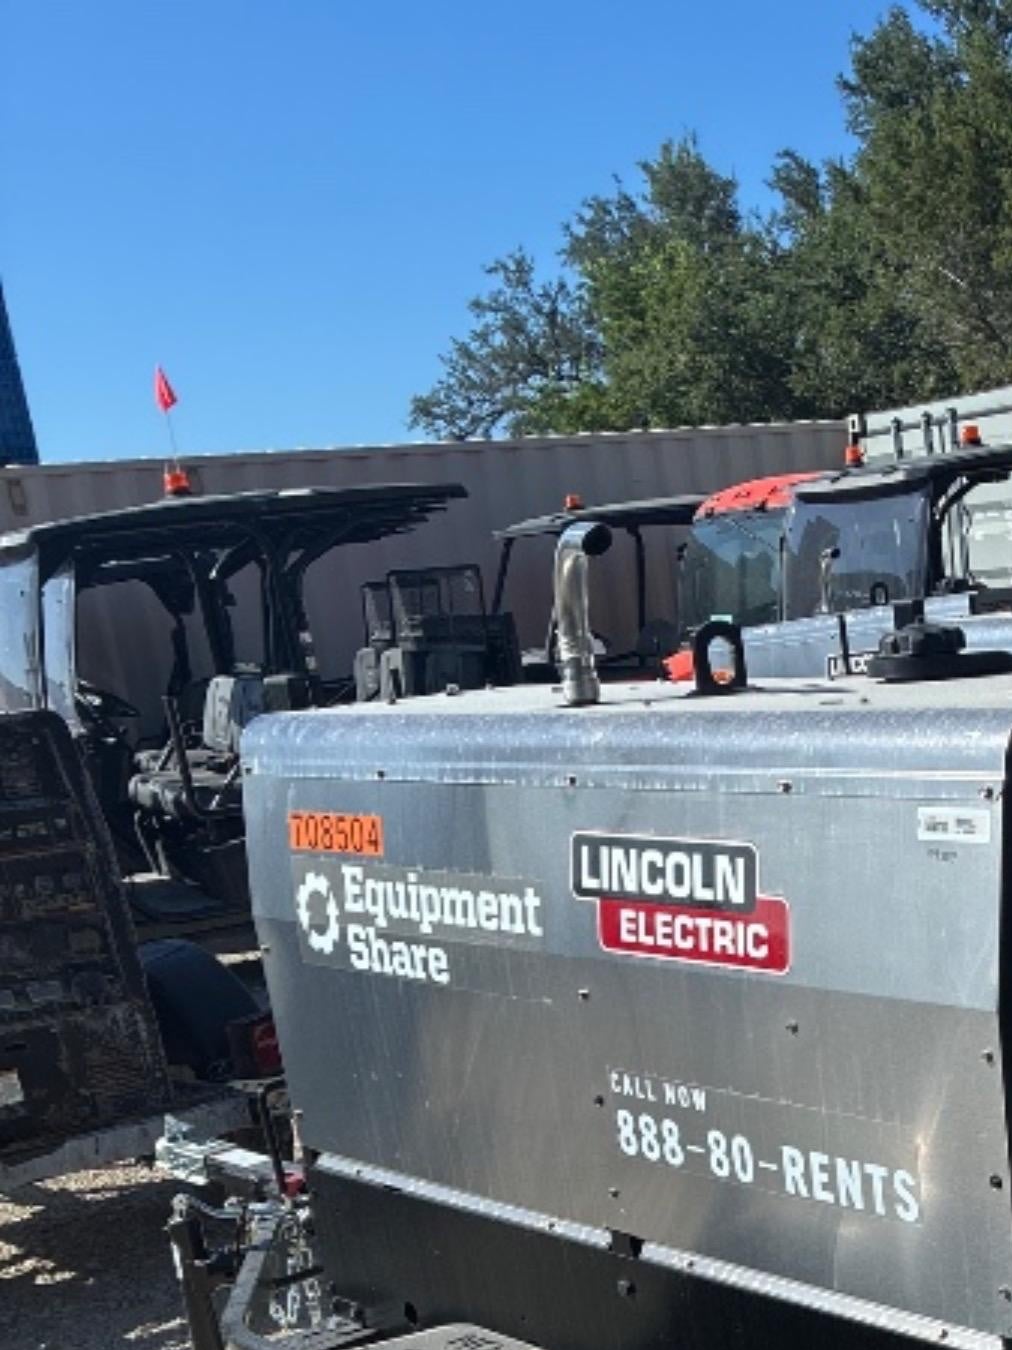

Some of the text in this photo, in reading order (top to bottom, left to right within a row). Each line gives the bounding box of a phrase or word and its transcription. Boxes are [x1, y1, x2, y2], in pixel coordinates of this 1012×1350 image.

[291, 814, 381, 853] 708504
[341, 864, 544, 937] Equipment
[580, 844, 746, 904] LINCOLN
[346, 922, 451, 985] Share
[619, 908, 769, 959] ELECTRIC
[610, 1072, 707, 1112] CALL NOW
[617, 1108, 920, 1223] 888-80-RENTS
